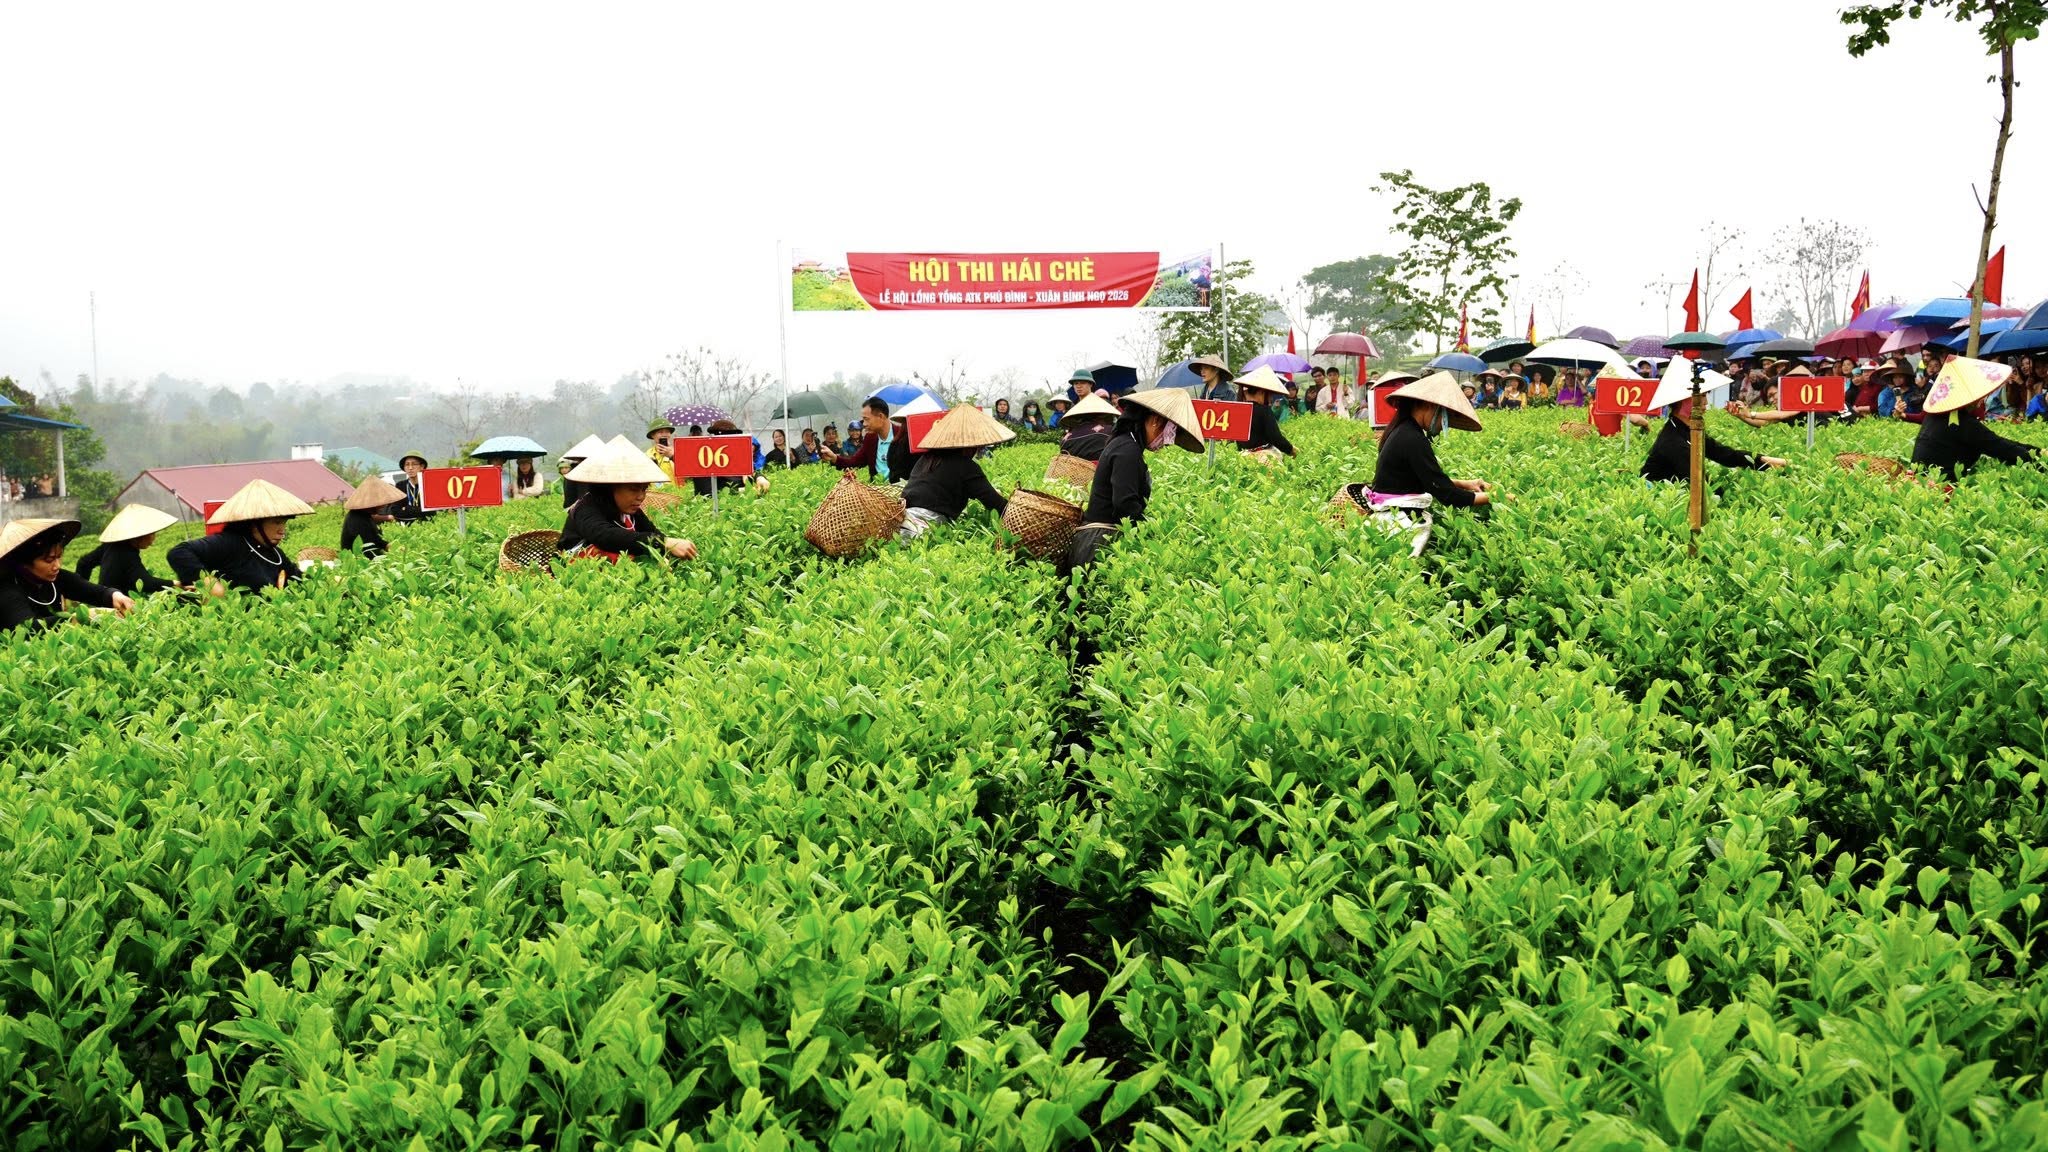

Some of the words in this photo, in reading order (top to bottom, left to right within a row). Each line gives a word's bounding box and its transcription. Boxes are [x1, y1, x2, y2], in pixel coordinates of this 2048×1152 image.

[909, 257, 950, 287] HỘI
[956, 261, 995, 282] THI
[1001, 257, 1042, 282] HÁI
[1049, 256, 1096, 282] CHÈ
[879, 288, 891, 304] LỄ
[893, 289, 909, 306] HỘI
[964, 291, 982, 303] ATK
[983, 289, 1003, 303] PHÚ
[1035, 289, 1061, 303] XUÂN
[1062, 289, 1086, 303] BÍNH
[1086, 290, 1106, 304] NGỌ
[1107, 289, 1129, 302] 2026
[1615, 385, 1643, 407] 02
[1799, 383, 1825, 405] 01
[1201, 408, 1230, 432] 04
[697, 444, 730, 469] 06
[447, 475, 478, 499] 07
